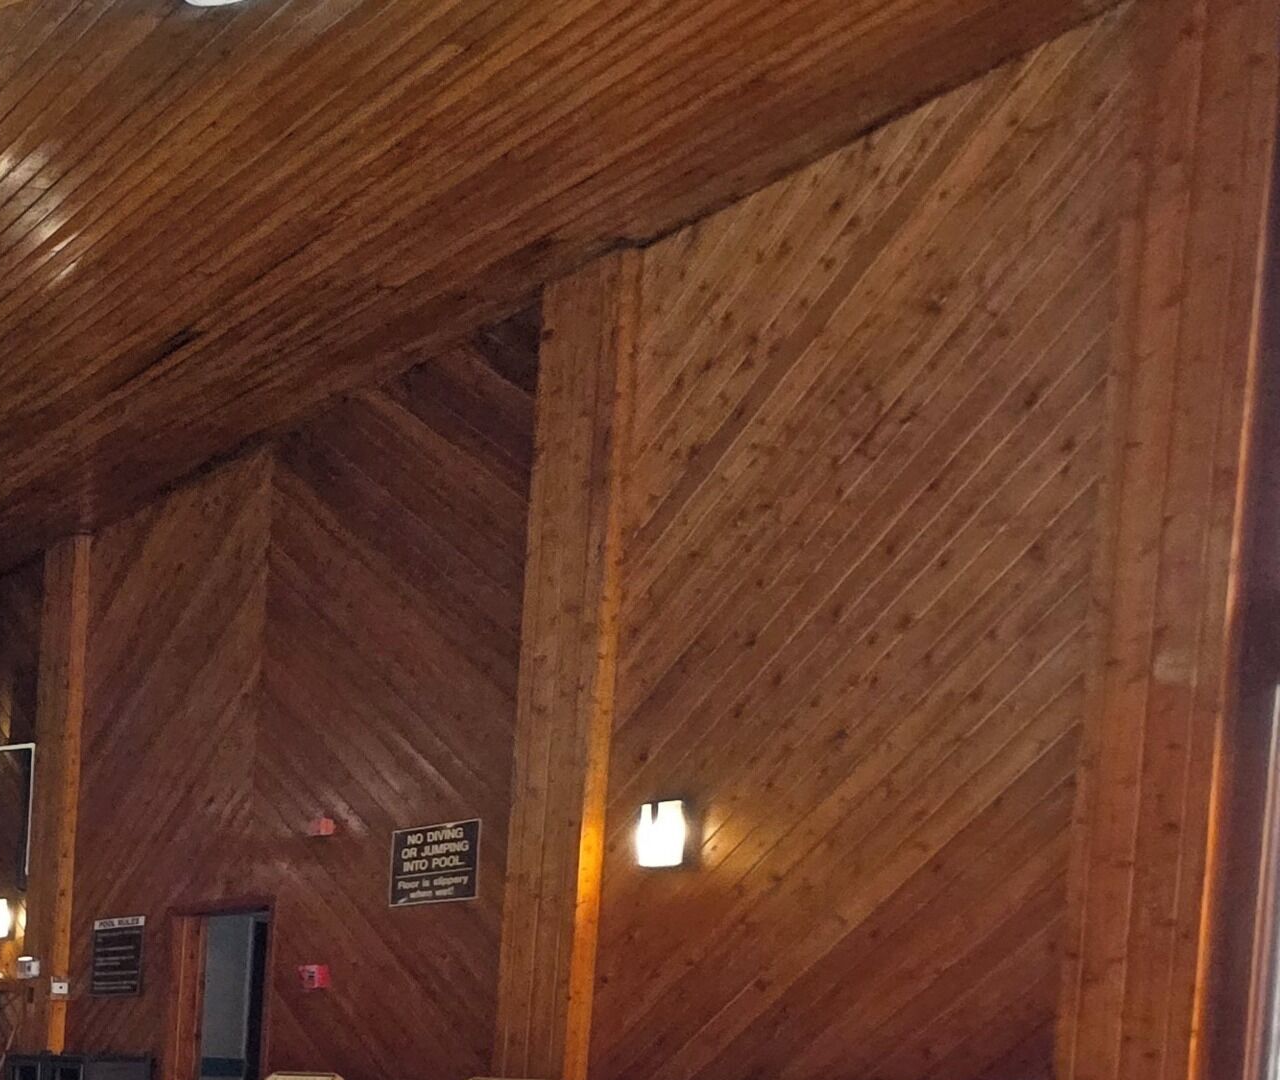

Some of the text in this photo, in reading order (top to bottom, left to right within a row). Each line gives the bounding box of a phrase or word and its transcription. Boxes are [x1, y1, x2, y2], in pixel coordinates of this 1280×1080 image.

[407, 827, 464, 845] NO DIVING
[401, 840, 469, 859] OR JUMPING
[403, 859, 428, 872] INTO
[397, 875, 469, 890] Floor is slippery
[409, 889, 433, 898] when
